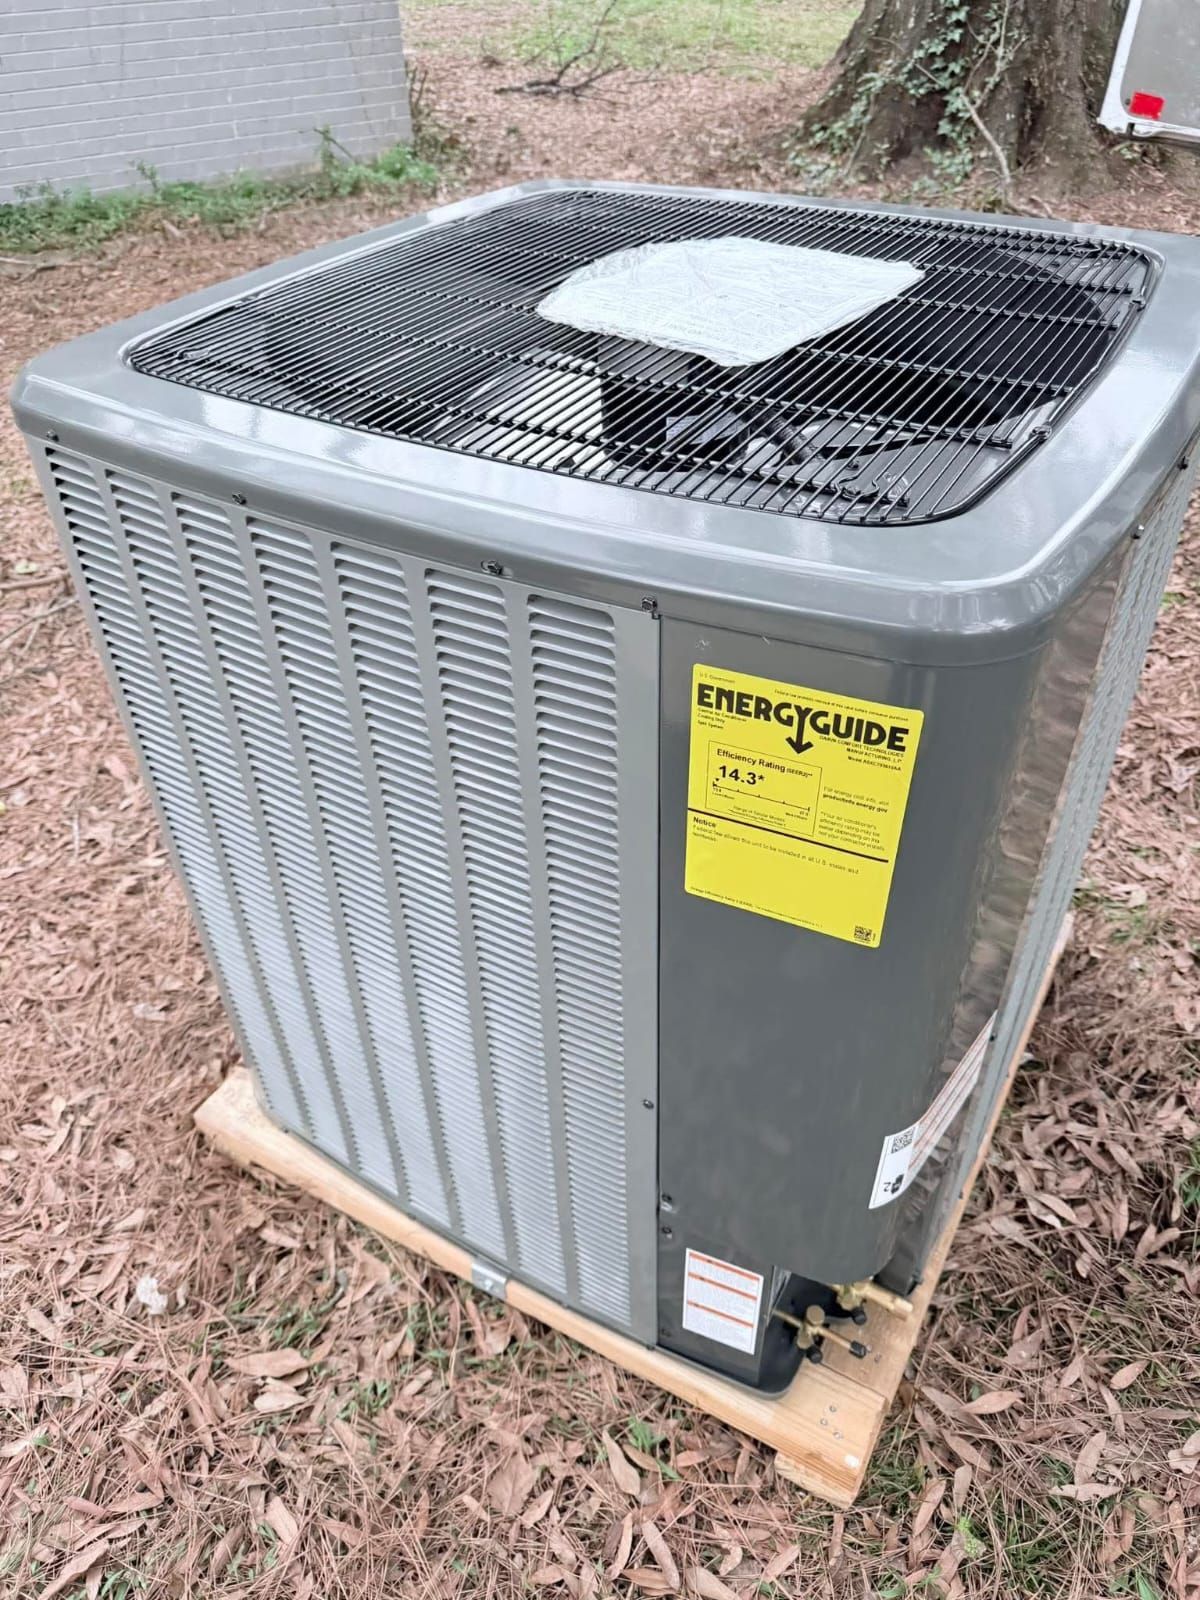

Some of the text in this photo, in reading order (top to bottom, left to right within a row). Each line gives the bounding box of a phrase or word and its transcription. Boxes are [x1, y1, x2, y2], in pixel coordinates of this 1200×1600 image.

[697, 682, 910, 754] ENERGYGUIDE
[717, 747, 757, 766] Efficiency
[759, 758, 785, 773] Rating
[693, 815, 717, 828] Notice
